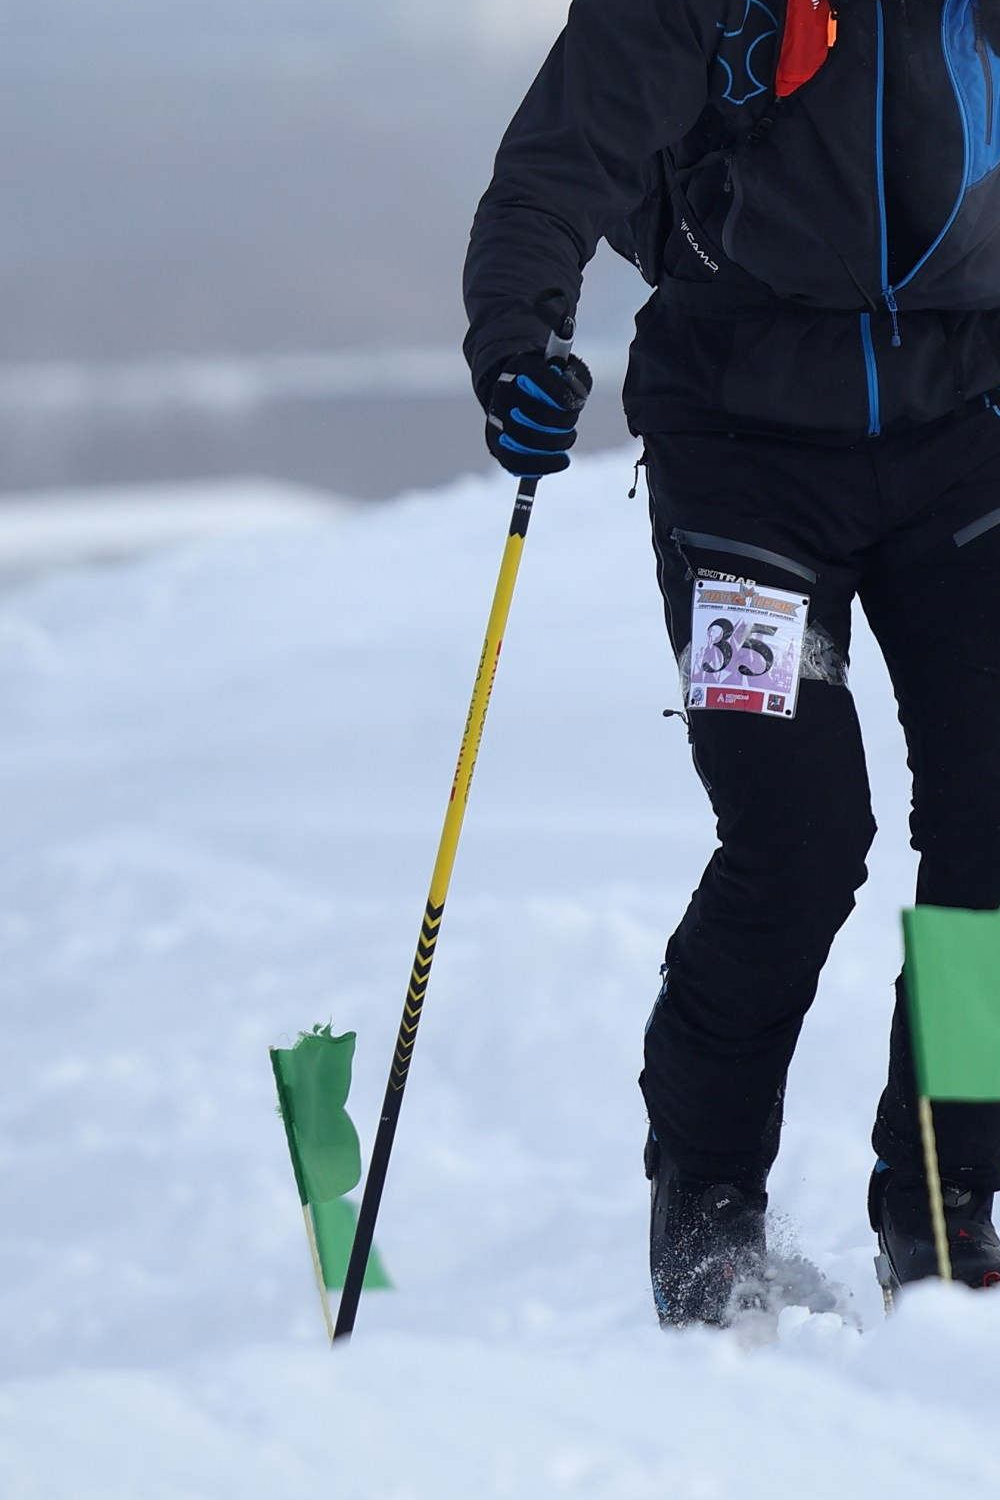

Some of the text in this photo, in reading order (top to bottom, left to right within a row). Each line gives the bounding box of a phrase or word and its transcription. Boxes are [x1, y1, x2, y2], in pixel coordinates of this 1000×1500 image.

[686, 232, 719, 272] CAMP
[703, 618, 778, 676] 35
[716, 1198, 731, 1209] BOA
